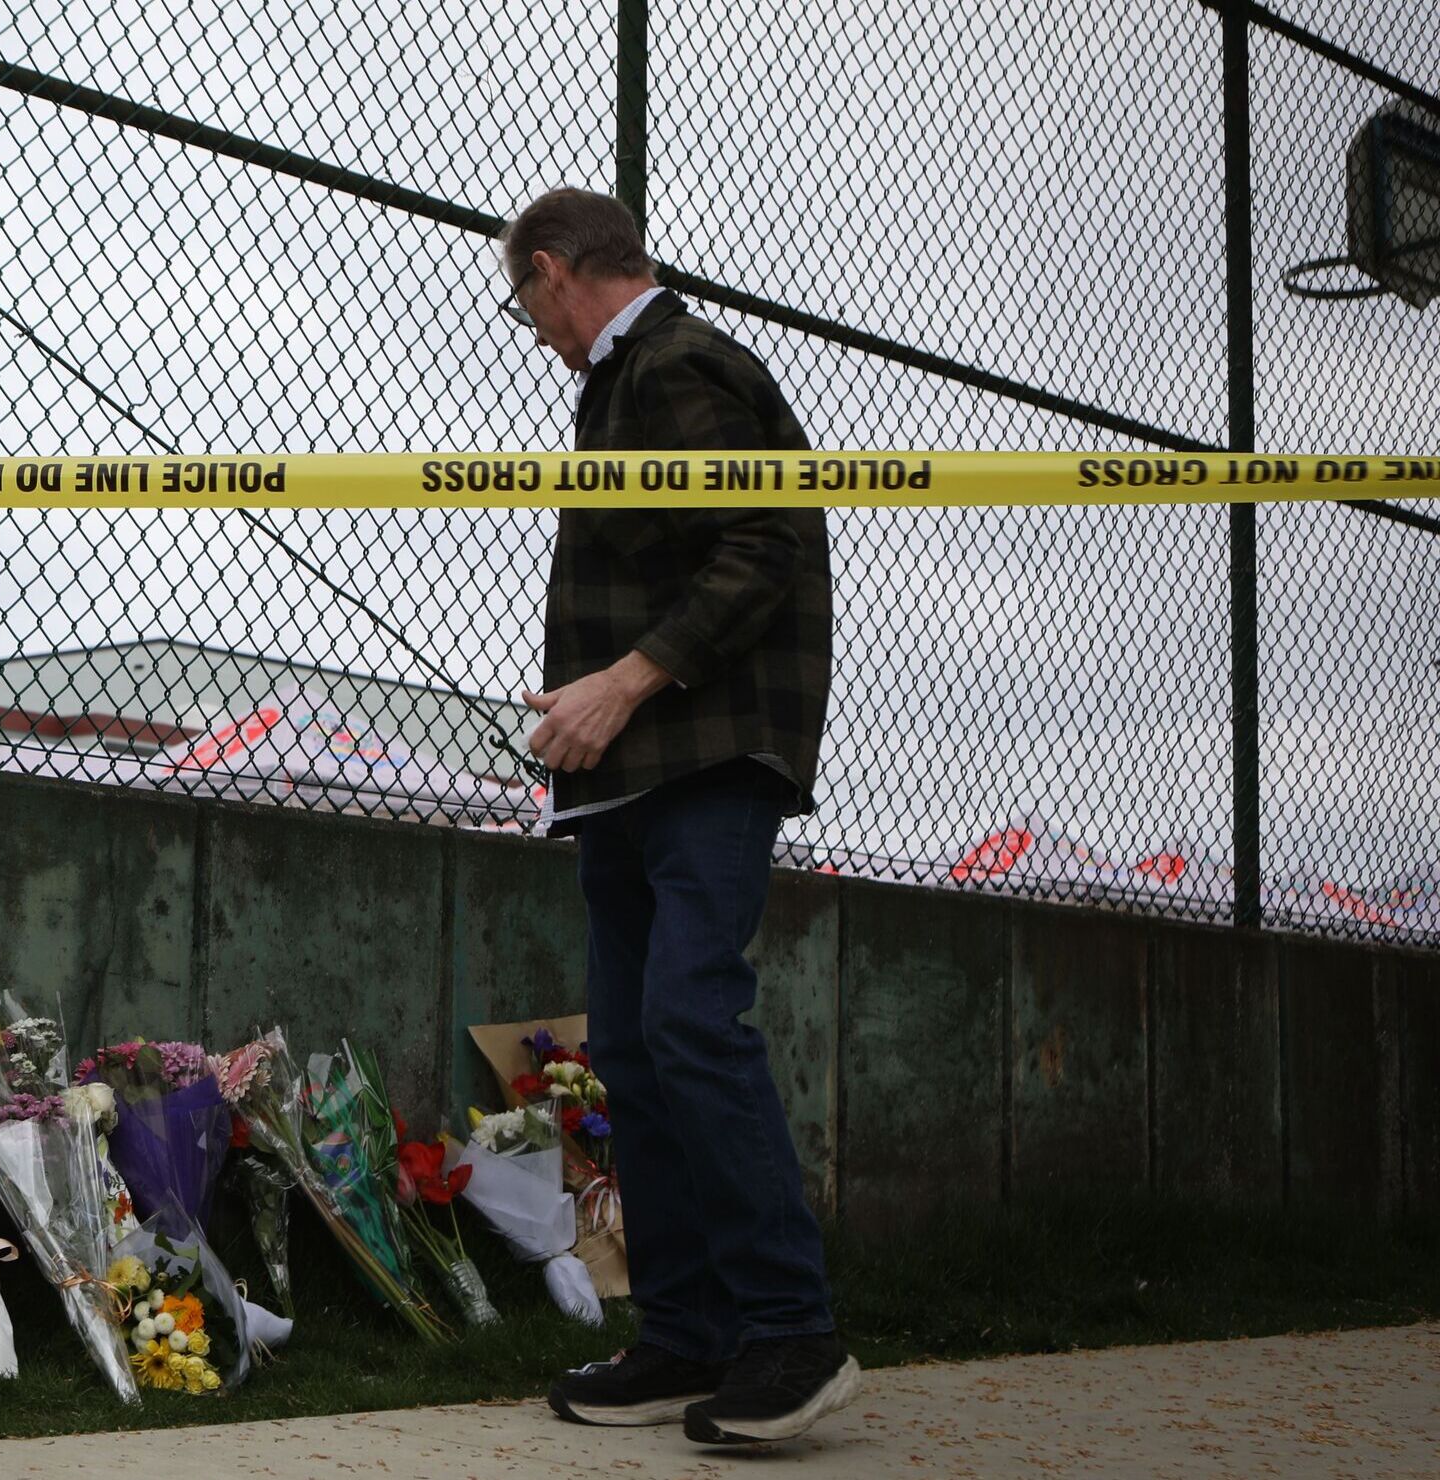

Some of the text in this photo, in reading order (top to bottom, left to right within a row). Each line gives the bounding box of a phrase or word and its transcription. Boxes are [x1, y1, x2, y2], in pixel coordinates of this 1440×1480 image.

[17, 463, 63, 493] DO
[75, 463, 149, 493] LINE
[162, 463, 286, 493] POLICE
[422, 459, 931, 493] POLICE LINE DO NOT CROSS
[1078, 459, 1208, 488] CROSS
[1218, 460, 1300, 485] NOT
[1313, 460, 1368, 483] DO
